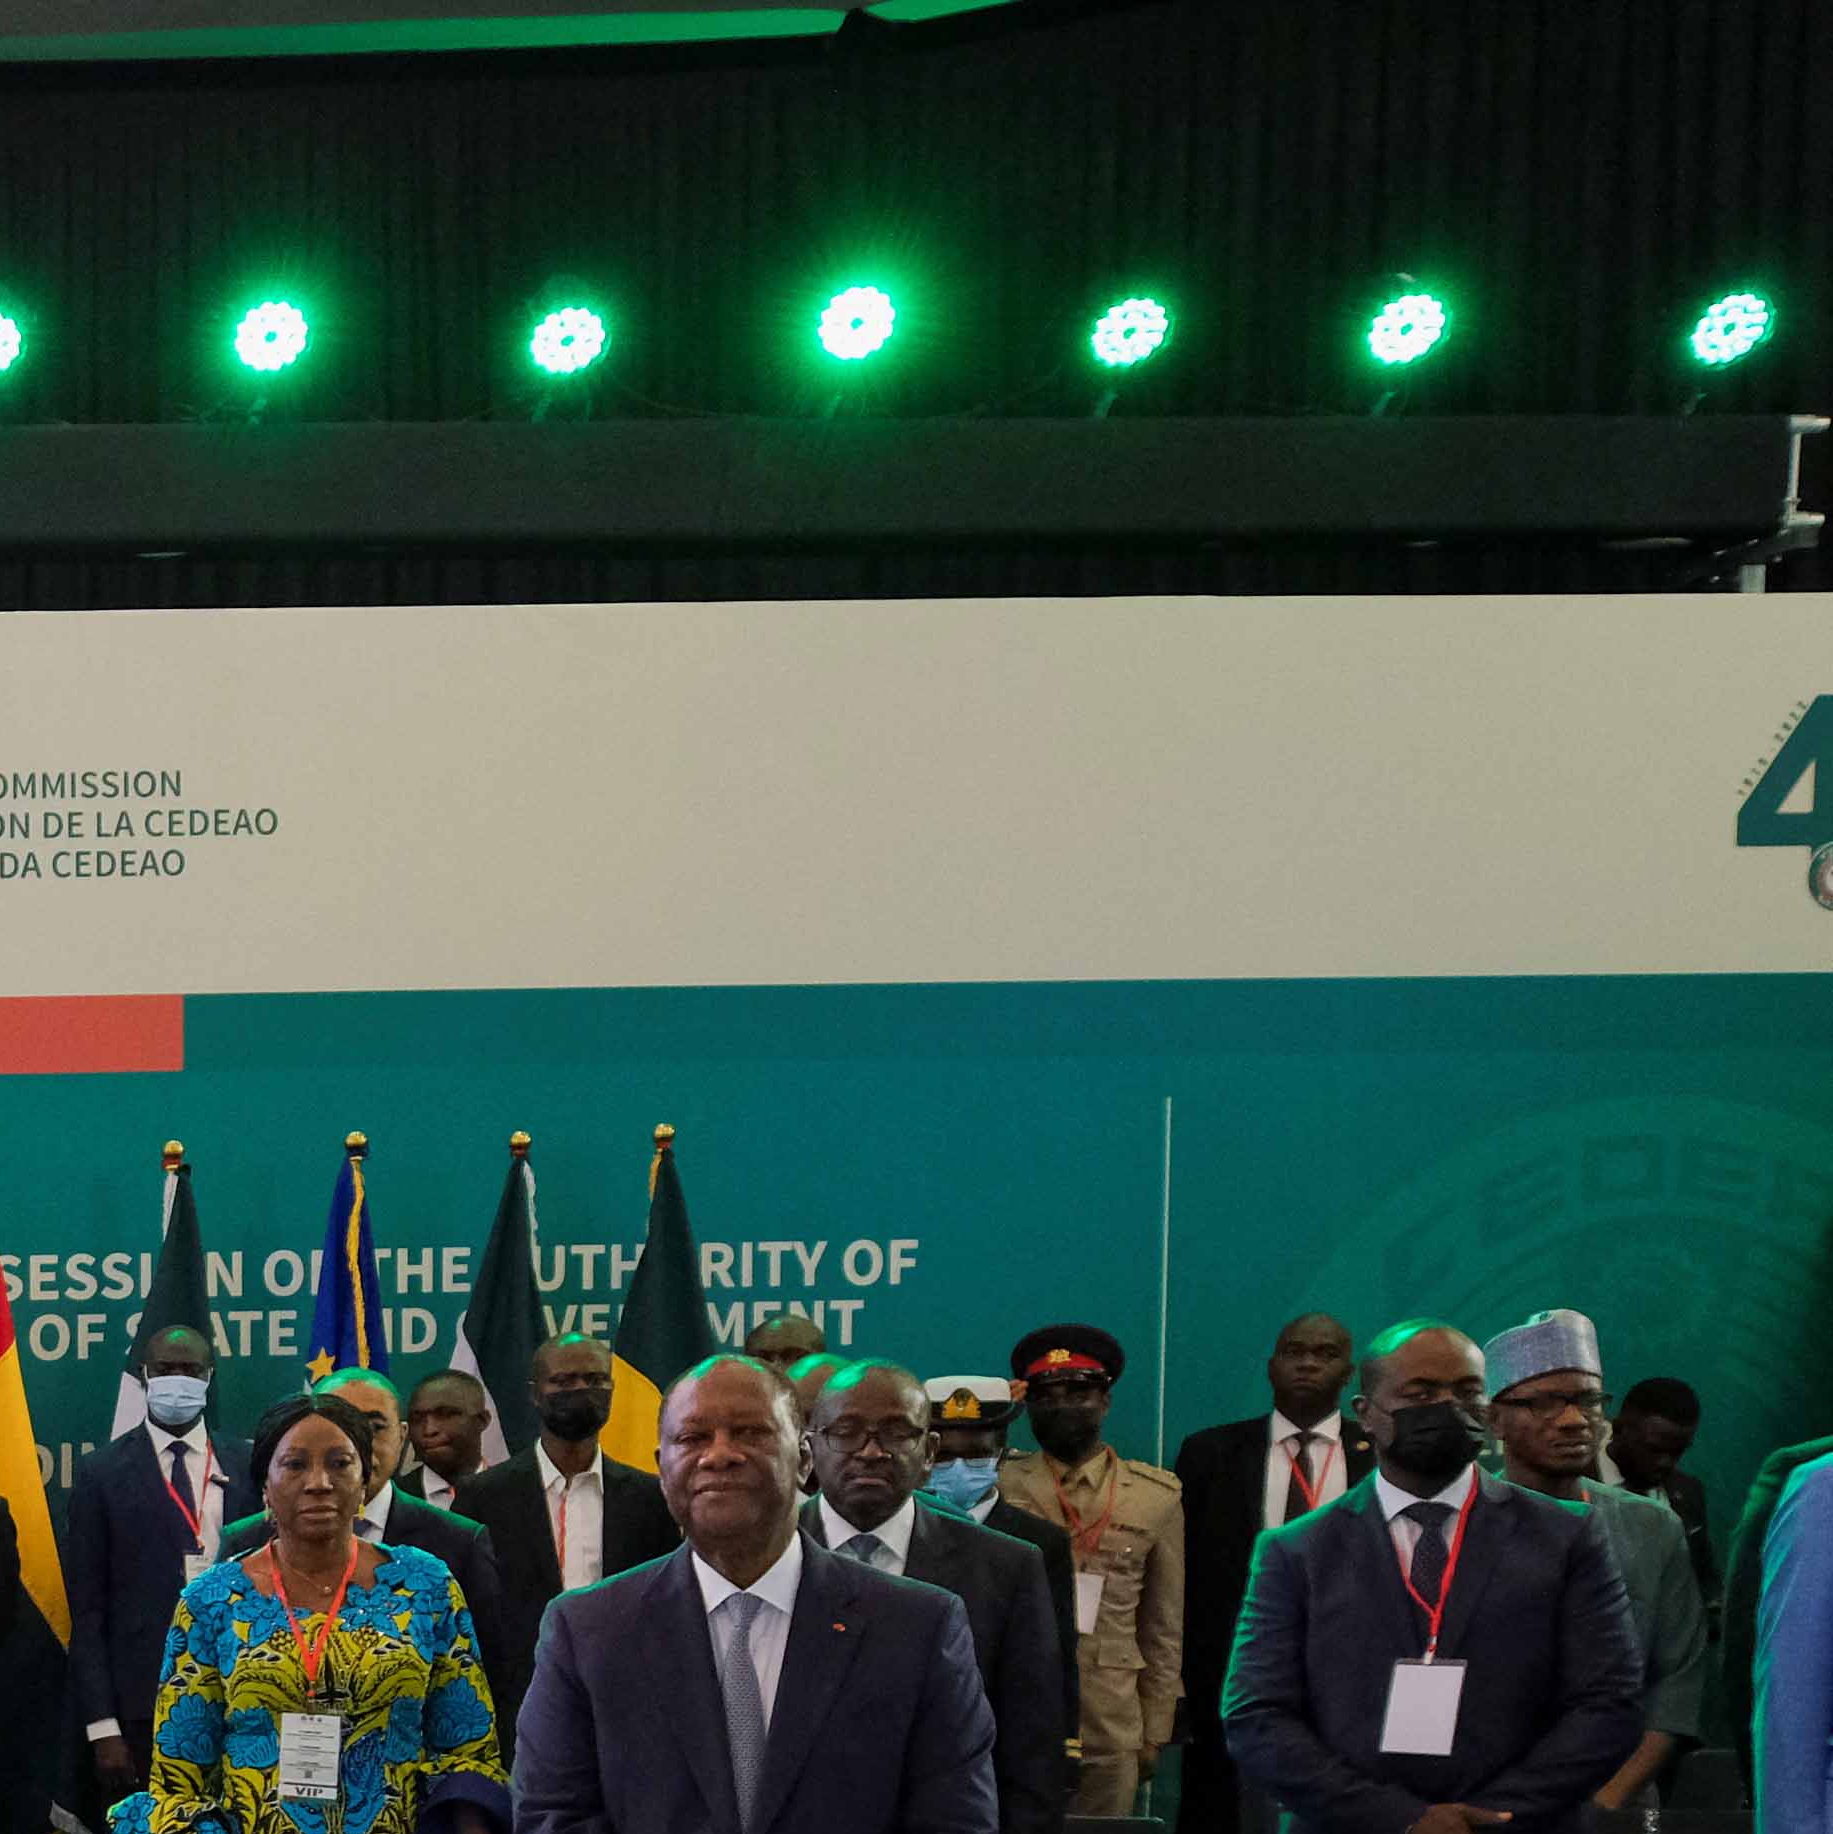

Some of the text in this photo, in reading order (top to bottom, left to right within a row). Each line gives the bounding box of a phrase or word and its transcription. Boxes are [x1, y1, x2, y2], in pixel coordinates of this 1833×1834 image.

[1737, 694, 1833, 848] 4
[43, 812, 84, 840] DE
[96, 811, 132, 838] LA
[144, 808, 278, 837] CEDEAO
[0, 851, 41, 880] DA
[52, 849, 185, 878] CEDEAO
[0, 1251, 244, 1302] SESSIN
[532, 1240, 828, 1292] UTHRITY
[843, 1239, 920, 1286] OF
[29, 1313, 107, 1361] OF
[294, 1786, 323, 1797] VIP
